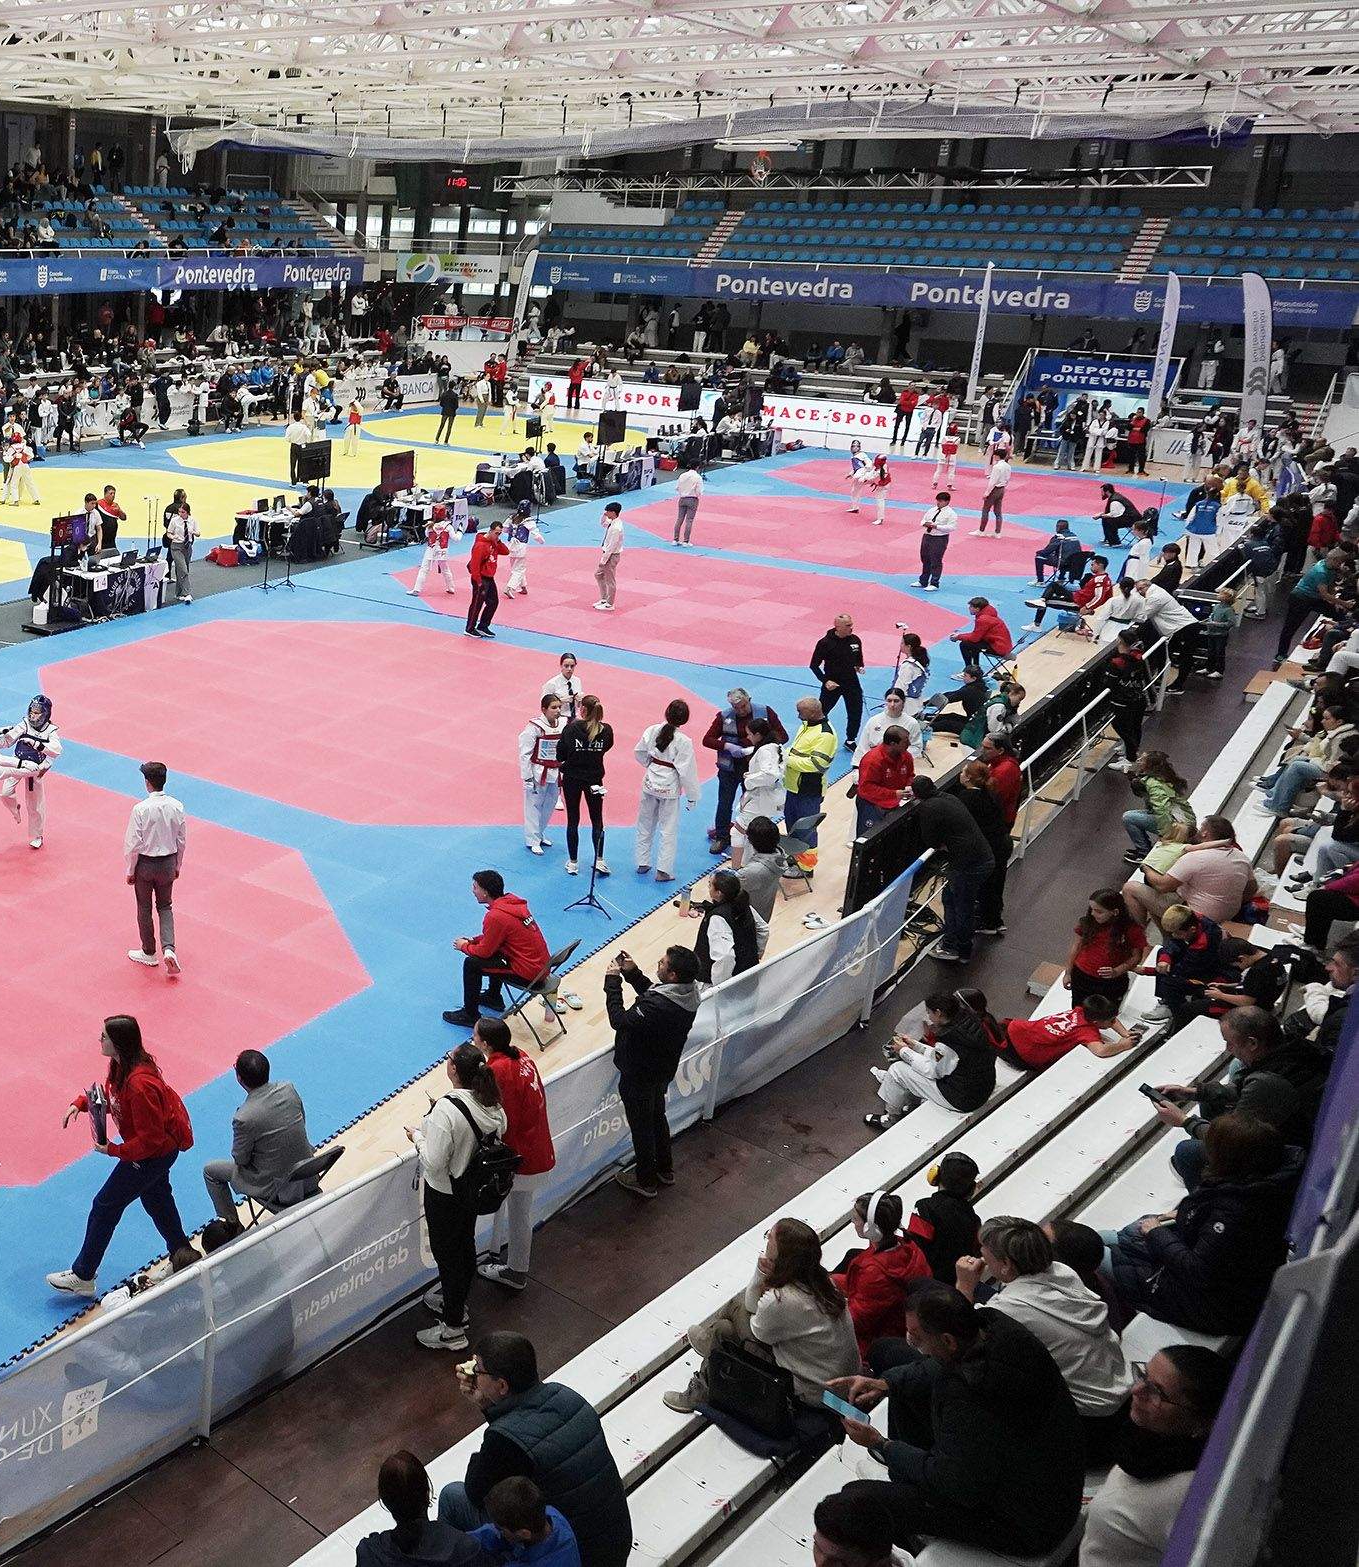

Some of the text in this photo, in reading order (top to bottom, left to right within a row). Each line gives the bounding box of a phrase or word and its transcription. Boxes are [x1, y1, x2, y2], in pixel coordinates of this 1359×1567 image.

[447, 177, 467, 187] 11:05
[174, 262, 256, 285] Pontevedra
[283, 262, 352, 283] Pontevedra
[715, 274, 854, 299] Pontevedra
[910, 281, 1071, 309] Pontevedra
[1061, 364, 1148, 379] DEPORTE
[401, 382, 434, 396] BANCA
[1040, 373, 1153, 389] PONTEVEDR
